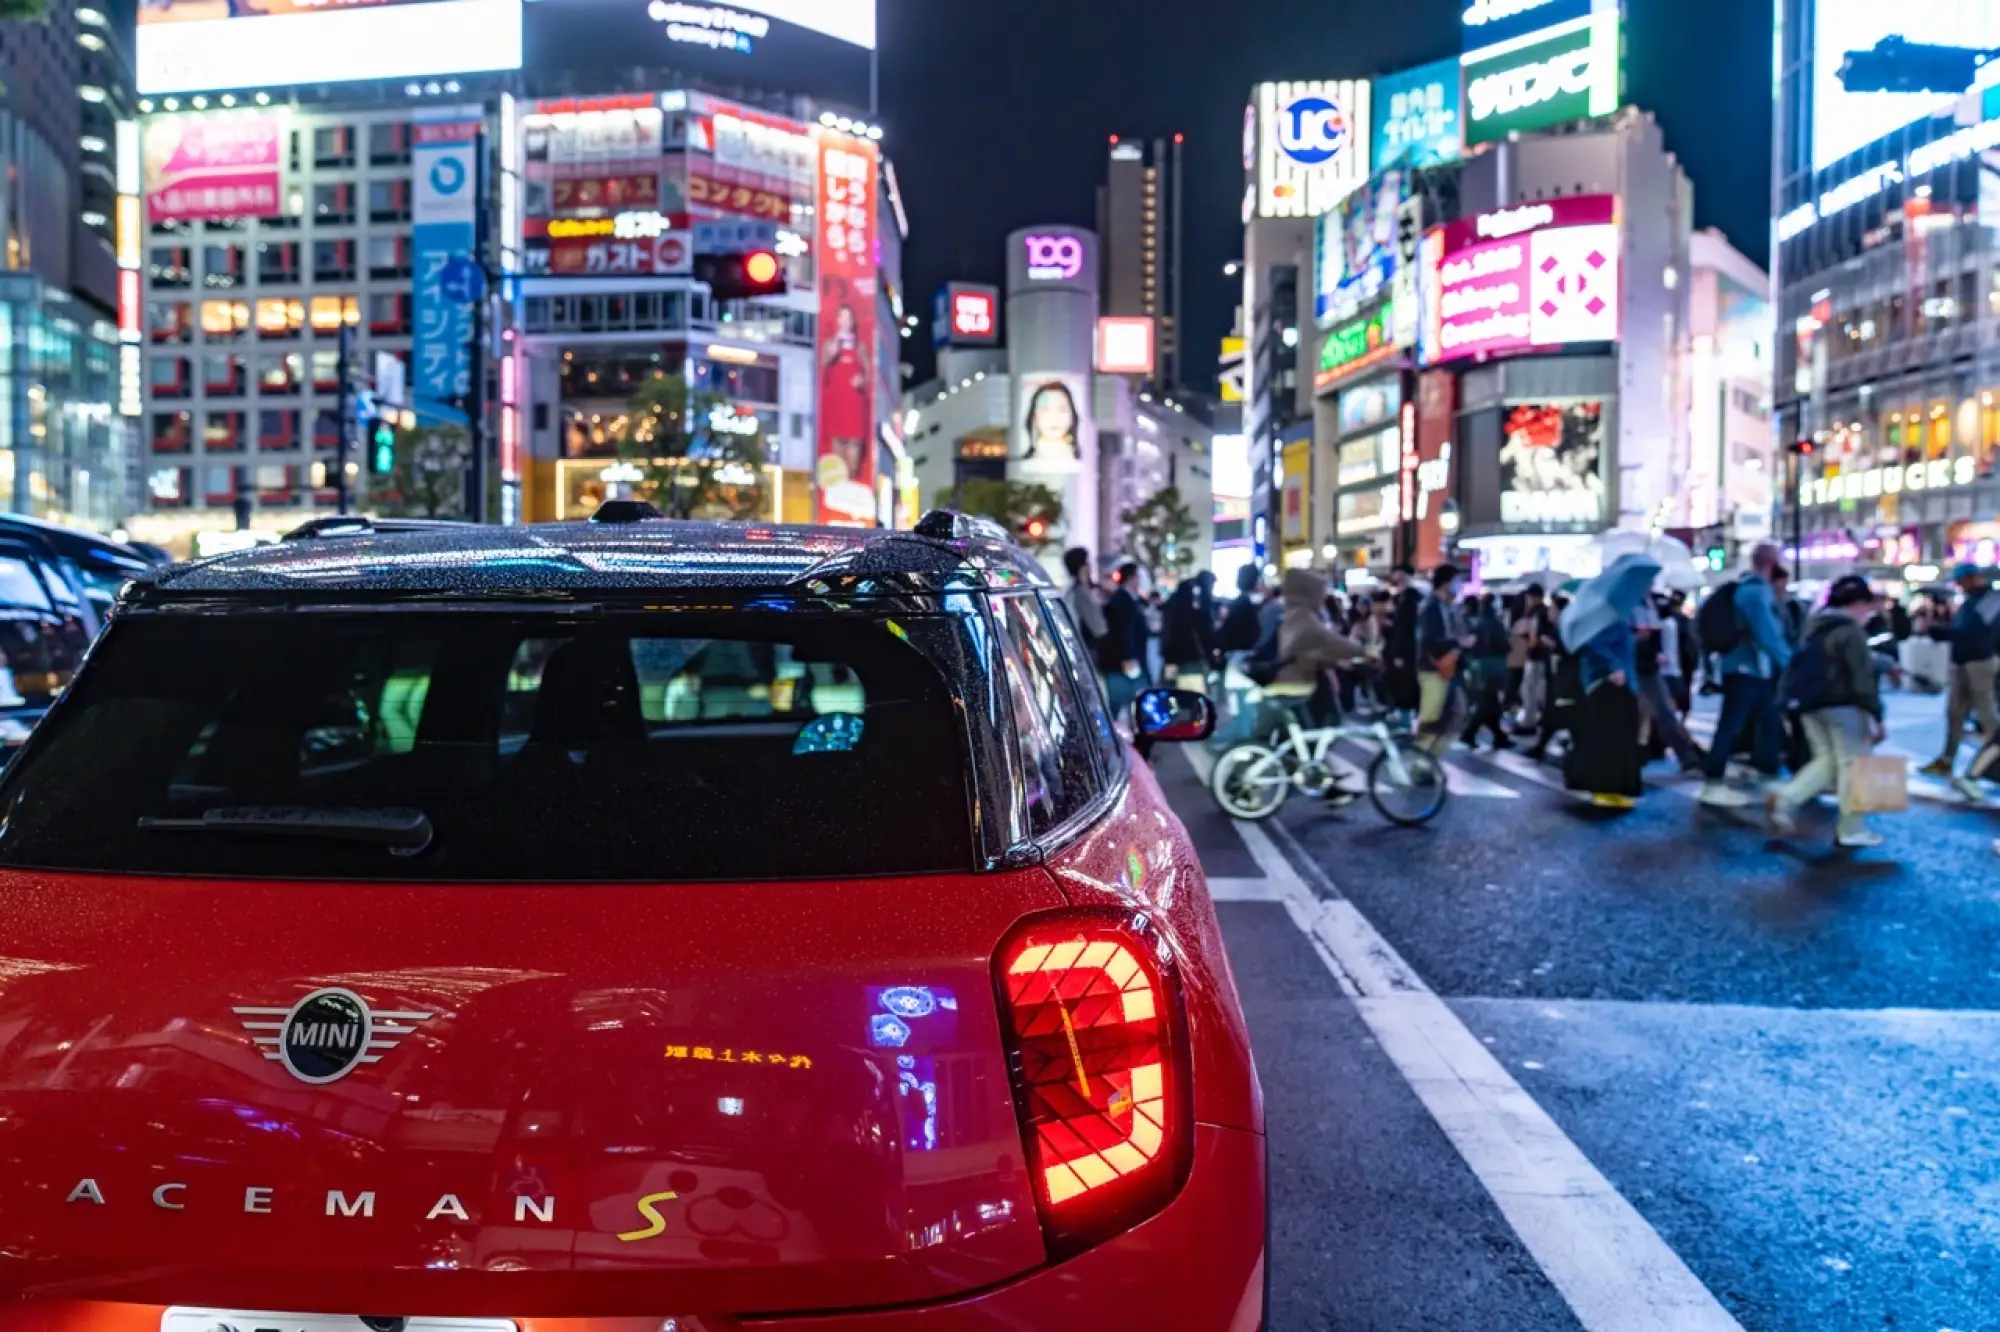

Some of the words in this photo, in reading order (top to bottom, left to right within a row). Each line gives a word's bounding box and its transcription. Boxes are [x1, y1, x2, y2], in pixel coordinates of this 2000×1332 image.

[1278, 109, 1346, 151] UC
[1024, 236, 1083, 279] 109
[422, 251, 449, 392] アイシティ
[1799, 456, 1975, 507] STARBUCKS
[291, 1022, 359, 1048] MINI
[66, 1178, 556, 1222] ACEMAN
[616, 1191, 678, 1242] S
